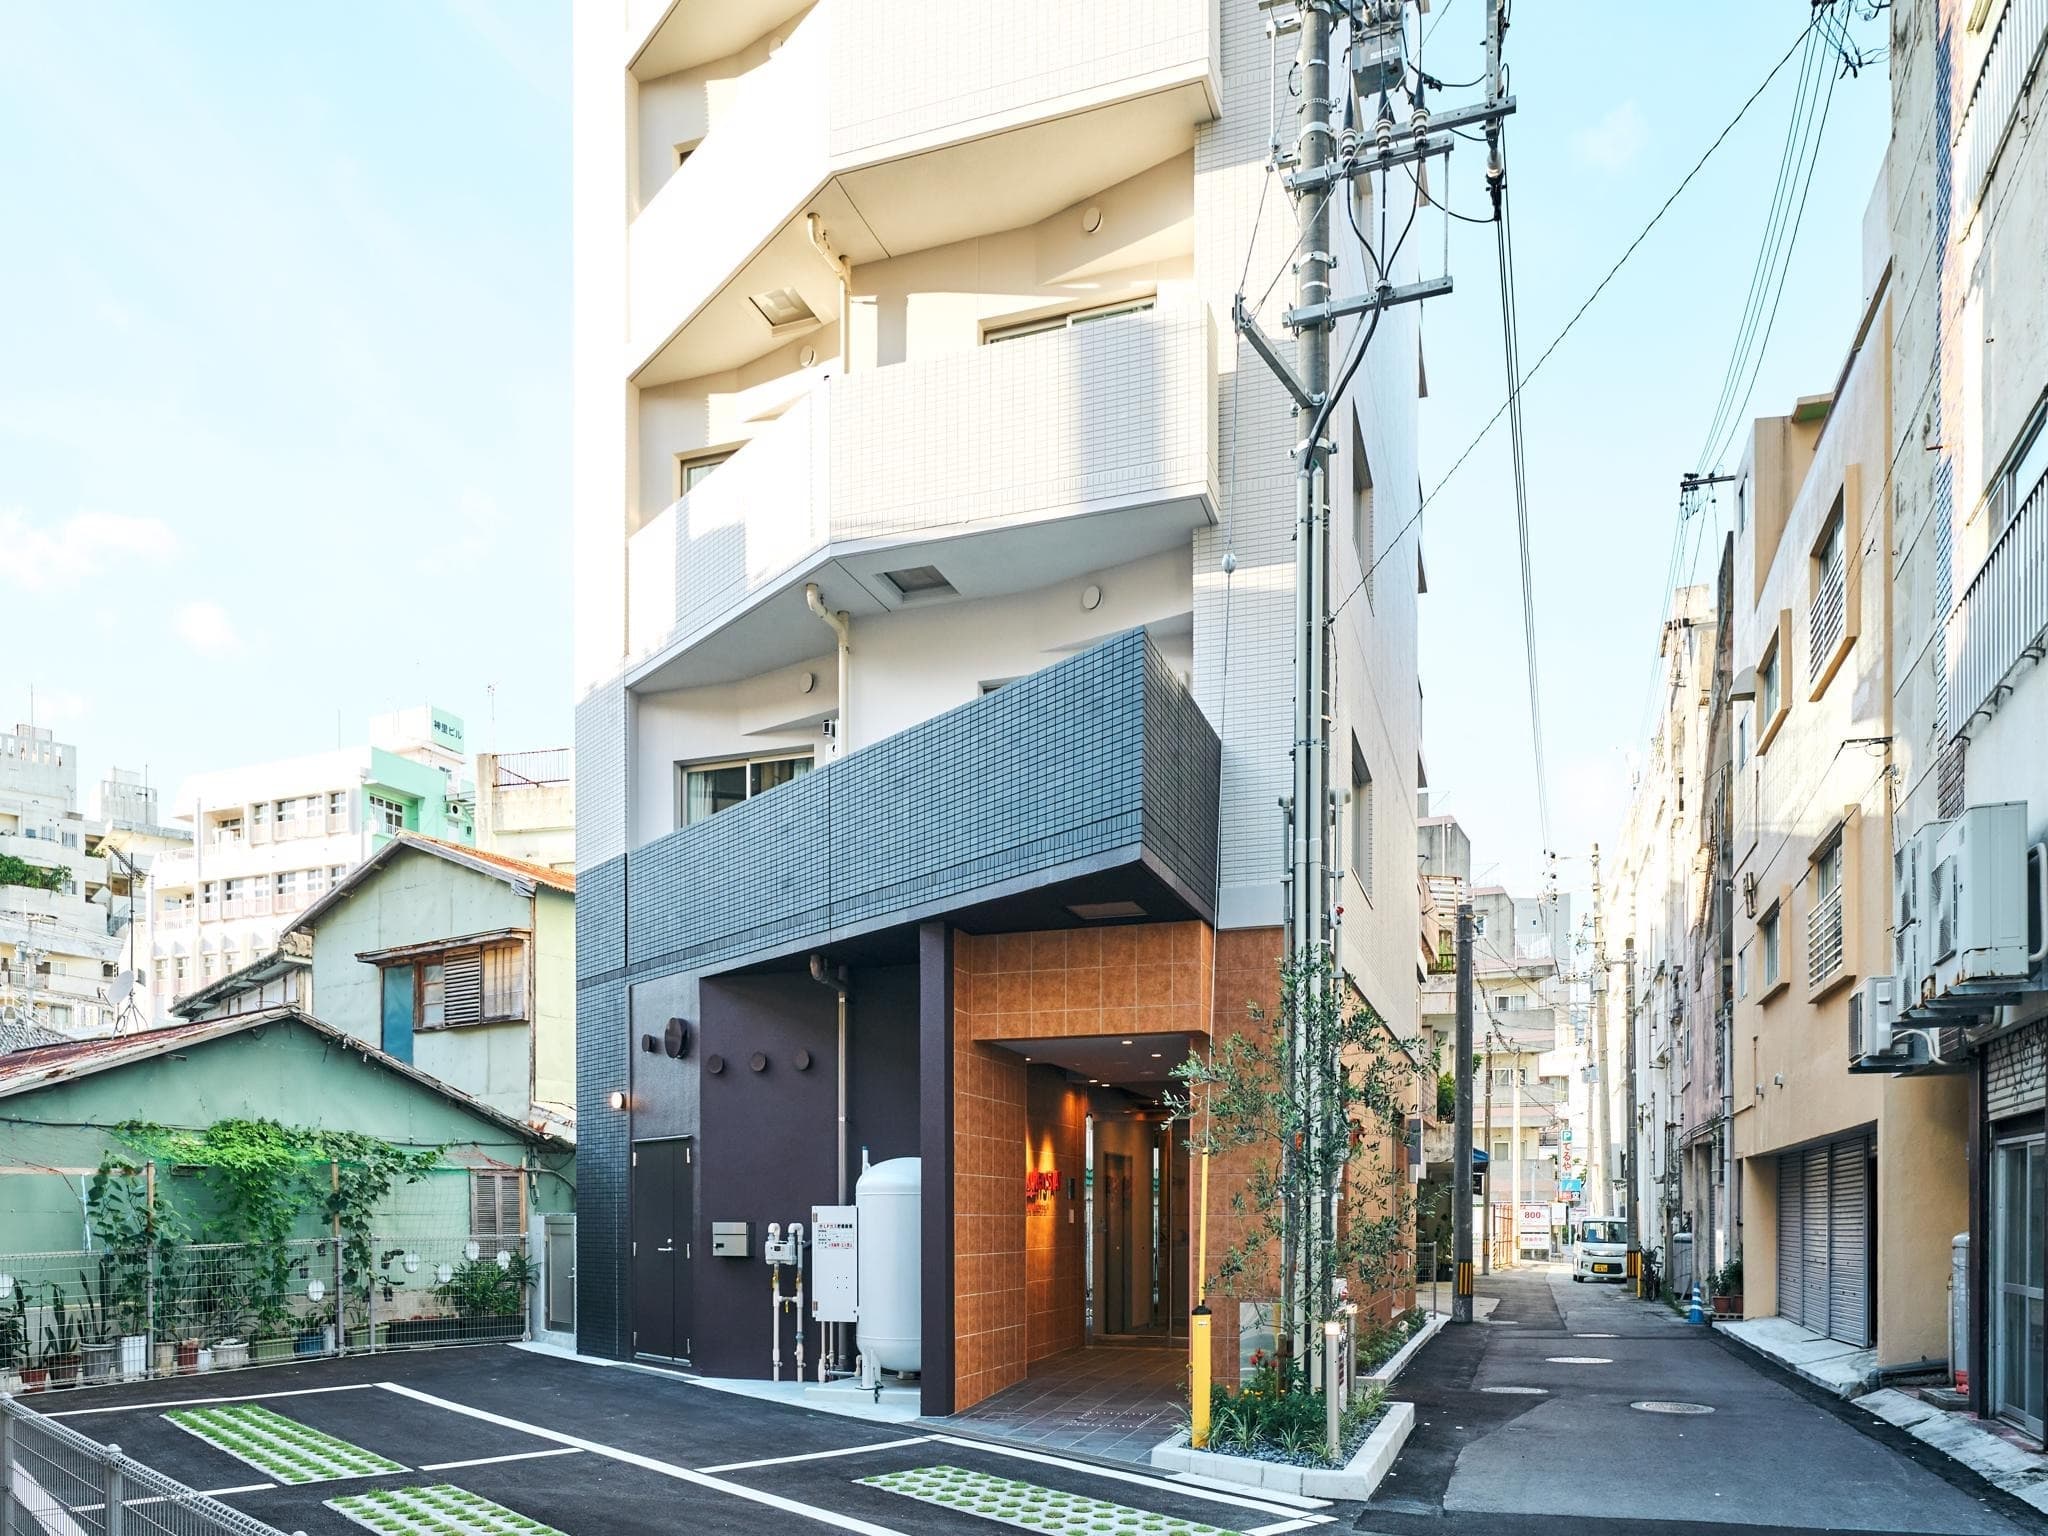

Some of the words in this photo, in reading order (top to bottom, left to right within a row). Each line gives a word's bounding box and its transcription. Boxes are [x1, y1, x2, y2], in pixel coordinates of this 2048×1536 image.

[1562, 1142, 1571, 1171] てるや
[1524, 1211, 1541, 1219] 800
